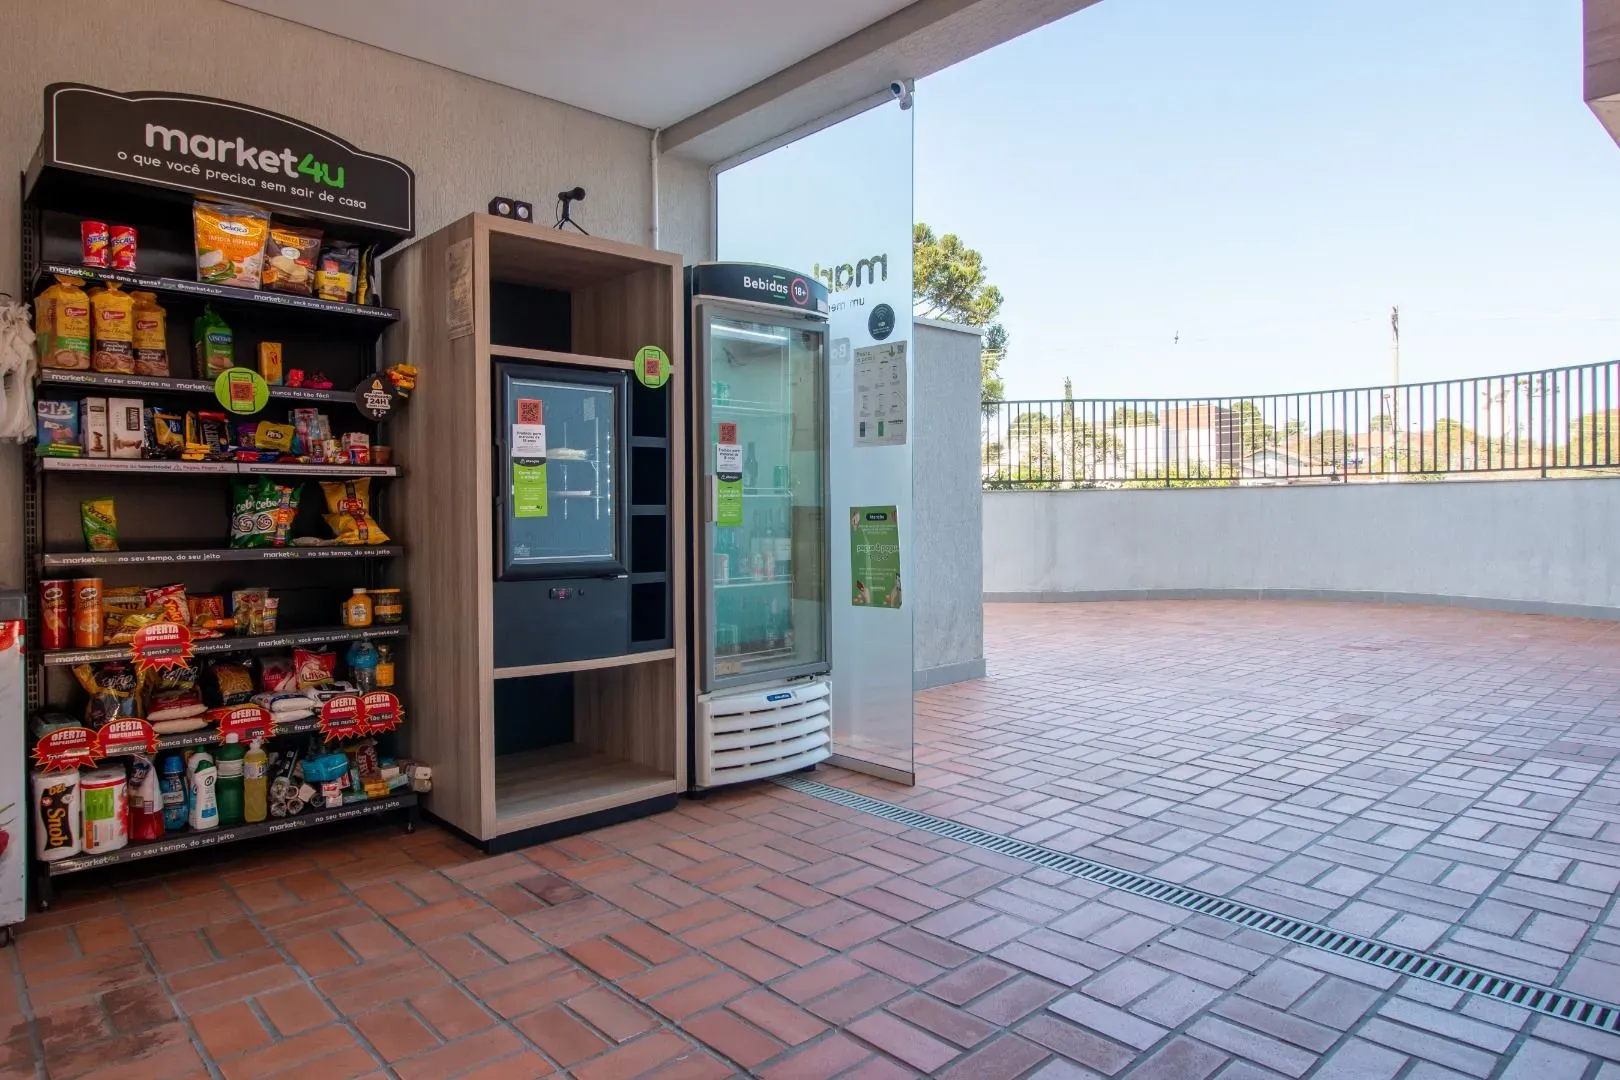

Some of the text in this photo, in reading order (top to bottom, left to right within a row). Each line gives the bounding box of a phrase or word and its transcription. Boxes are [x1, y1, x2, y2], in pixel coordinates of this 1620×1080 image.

[145, 123, 344, 189] market4u
[117, 151, 367, 209] o que você precisa sem sair de casa
[49, 265, 94, 278] market4u
[743, 276, 807, 297] Bebidas 18+
[254, 294, 290, 305] market4u
[51, 374, 97, 384] market4u
[104, 377, 125, 385] fazer
[126, 379, 160, 389] compras
[63, 556, 108, 565] market4u
[147, 554, 174, 563] tempo,
[203, 553, 221, 561] jeito
[263, 550, 300, 559] market4u
[145, 623, 180, 635] OFERTA
[193, 642, 232, 652] market4u.br
[258, 638, 295, 648] market4u
[330, 697, 357, 708] OFERTA
[365, 694, 390, 705] OFERTA
[231, 708, 261, 720] OFERTA
[109, 720, 143, 733] OFERTA
[51, 730, 87, 741] OFERTA
[47, 807, 69, 847] Snob
[269, 820, 306, 832] market4u
[160, 843, 188, 852] tempo,
[202, 837, 215, 845] seu
[217, 833, 235, 843] jeito
